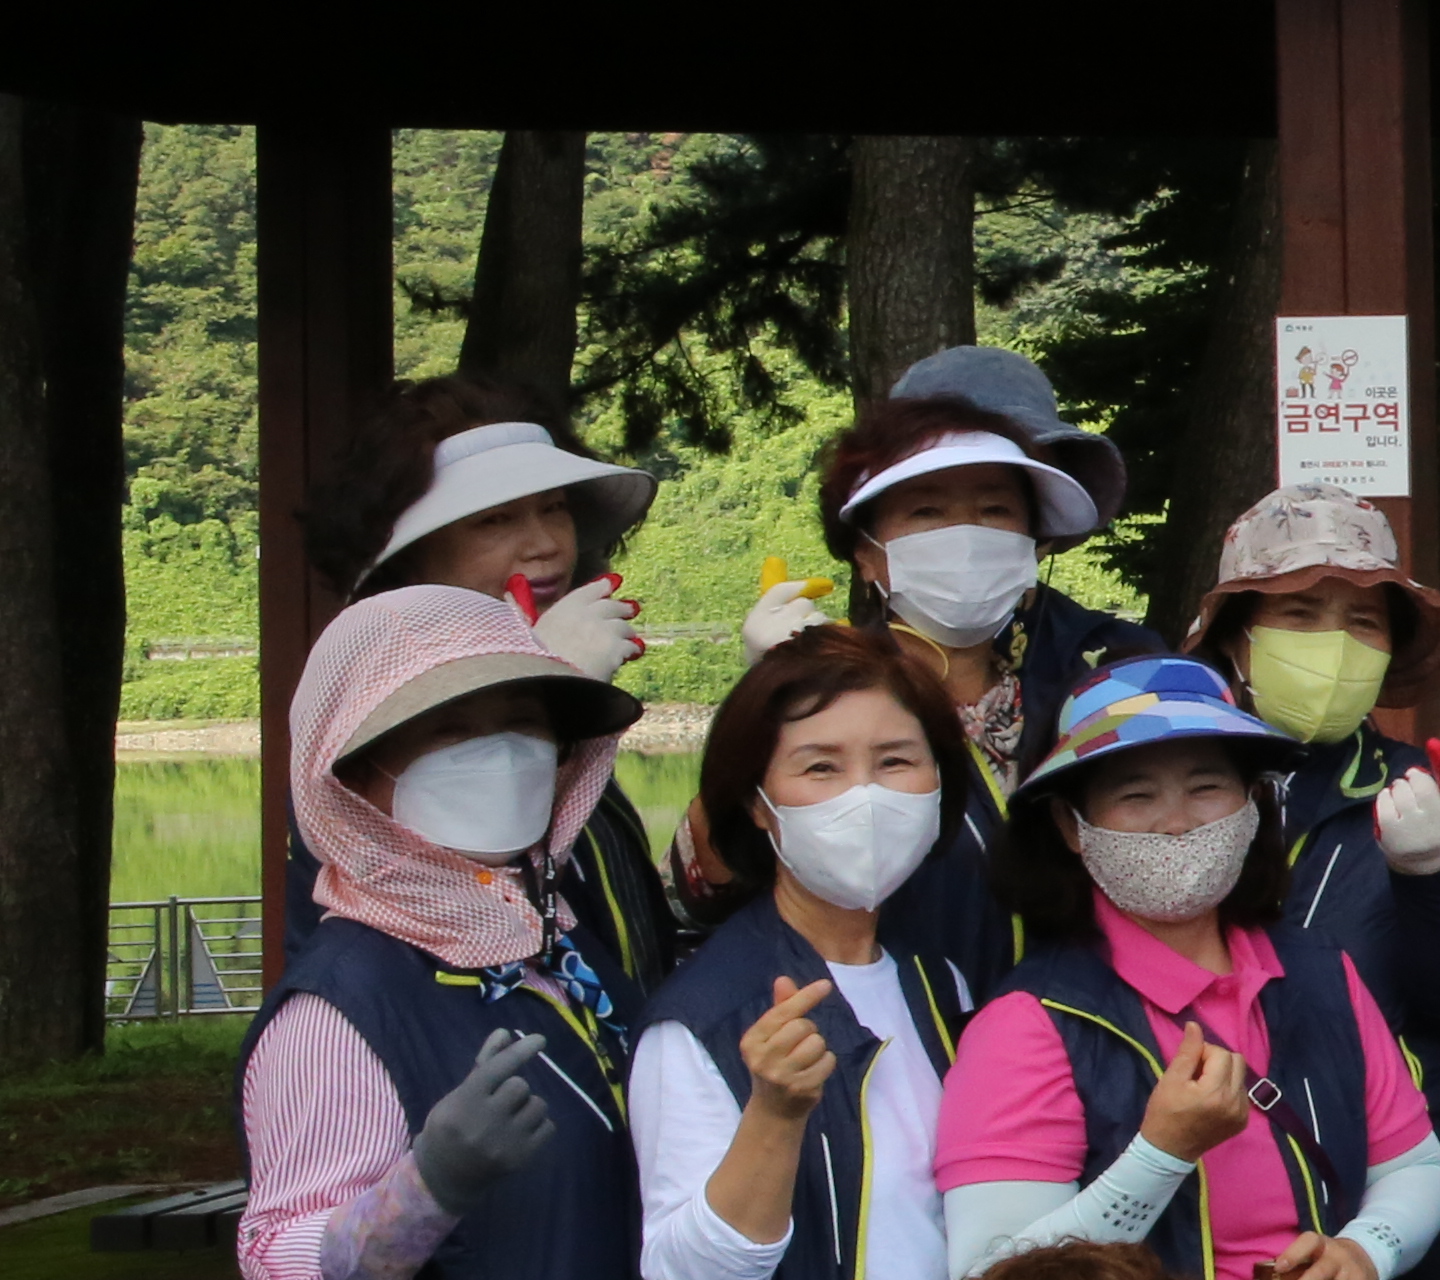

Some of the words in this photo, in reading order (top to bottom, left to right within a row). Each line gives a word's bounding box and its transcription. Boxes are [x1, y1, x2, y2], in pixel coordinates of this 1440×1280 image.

[1365, 386, 1398, 399] 이곳은
[1284, 402, 1399, 432] 금연구역
[1365, 436, 1402, 447] 입니다.
